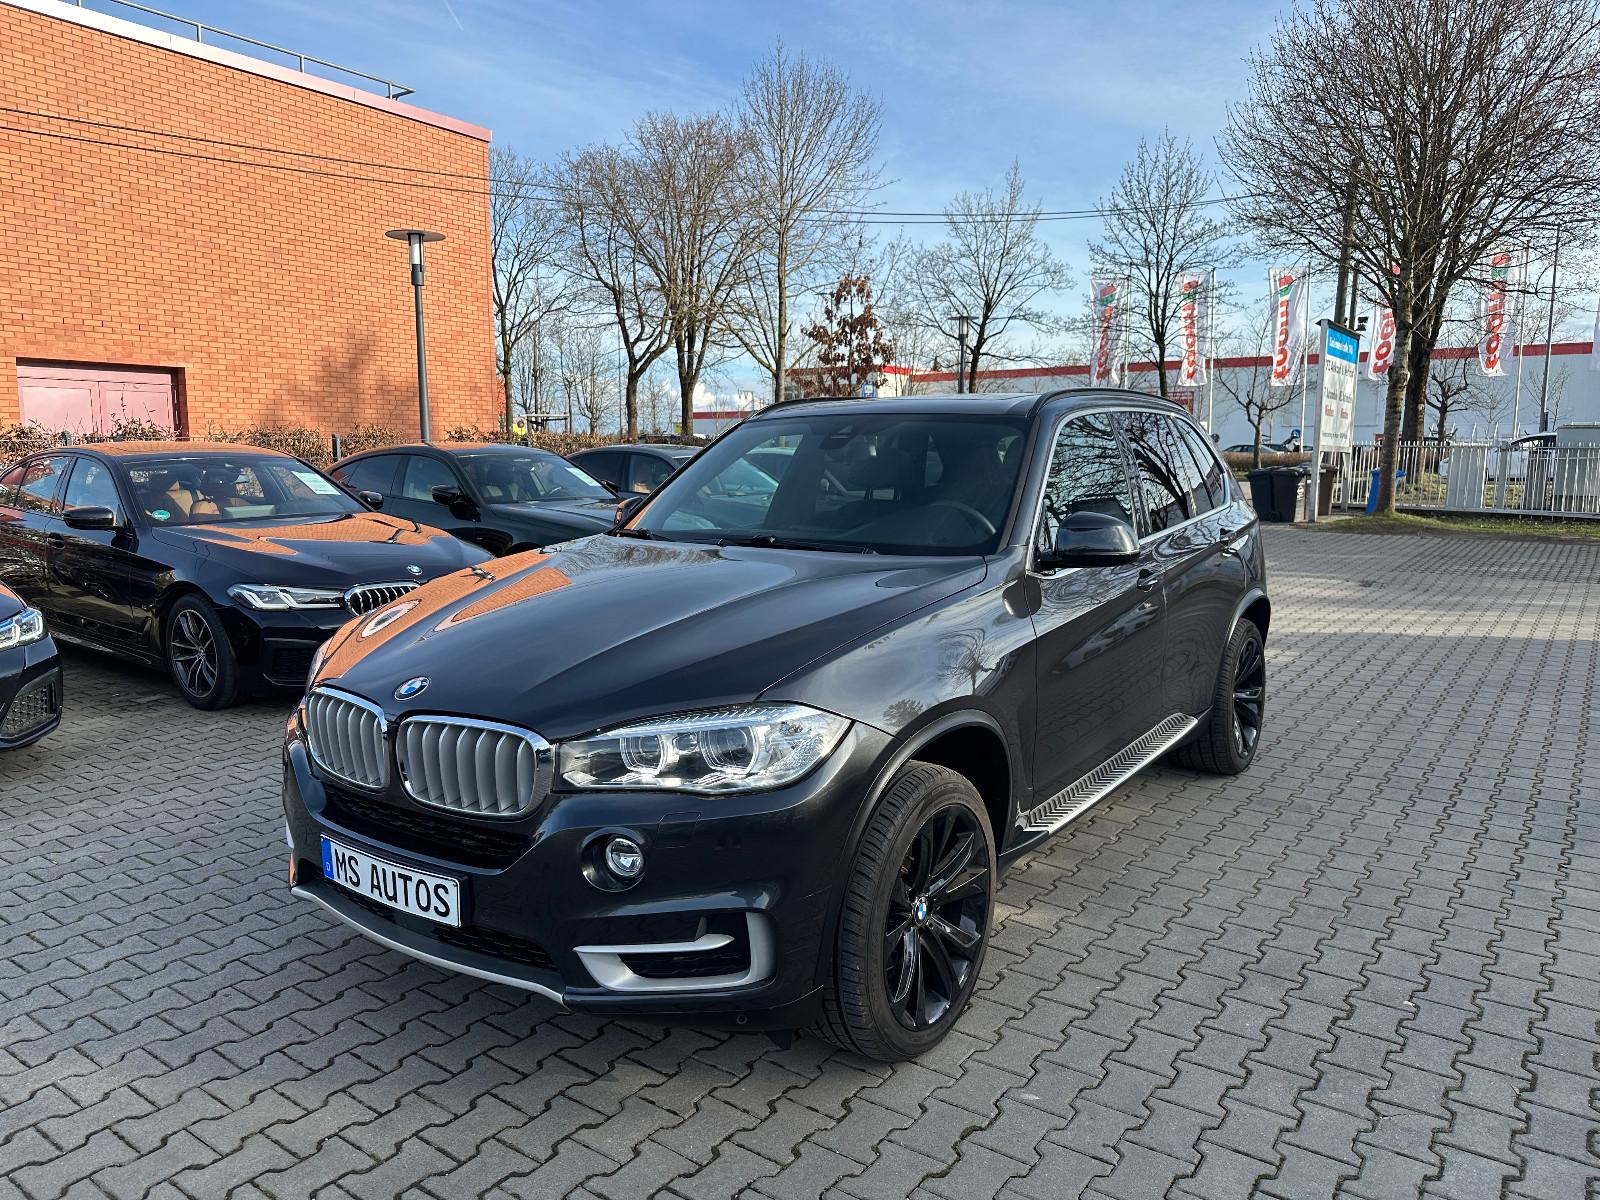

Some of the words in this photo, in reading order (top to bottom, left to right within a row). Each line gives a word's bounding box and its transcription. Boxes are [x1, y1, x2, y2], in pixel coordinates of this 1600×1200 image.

[1274, 299, 1290, 379] toom
[334, 848, 361, 888] MS
[370, 863, 450, 917] AUTOS
